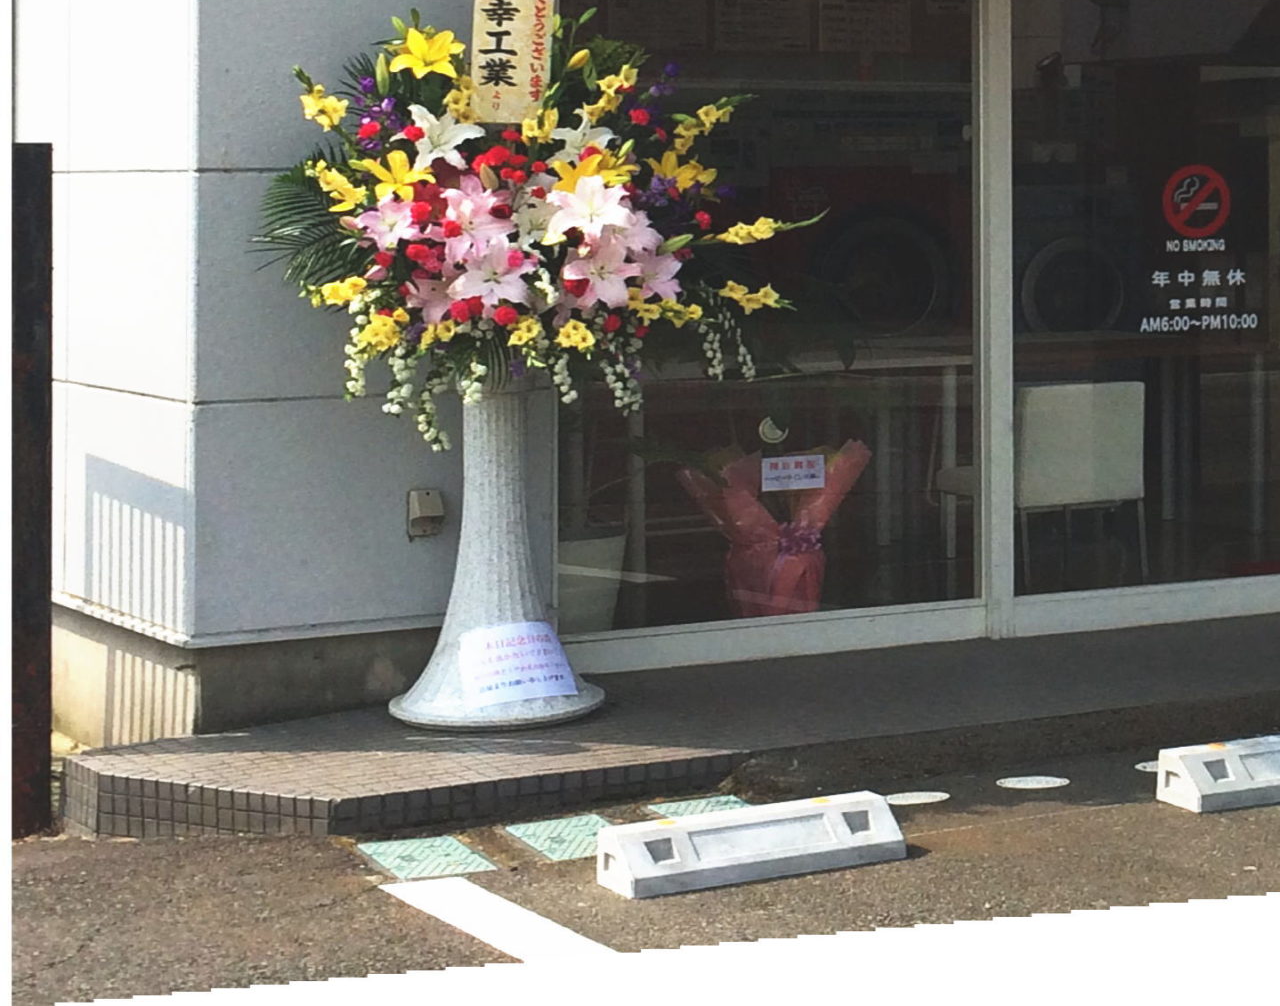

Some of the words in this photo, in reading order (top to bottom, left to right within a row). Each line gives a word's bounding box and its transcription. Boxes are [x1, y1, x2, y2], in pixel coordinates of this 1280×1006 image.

[1166, 240, 1180, 252] NO
[1183, 239, 1226, 252] SMOKING
[1152, 269, 1246, 287] 年中無休
